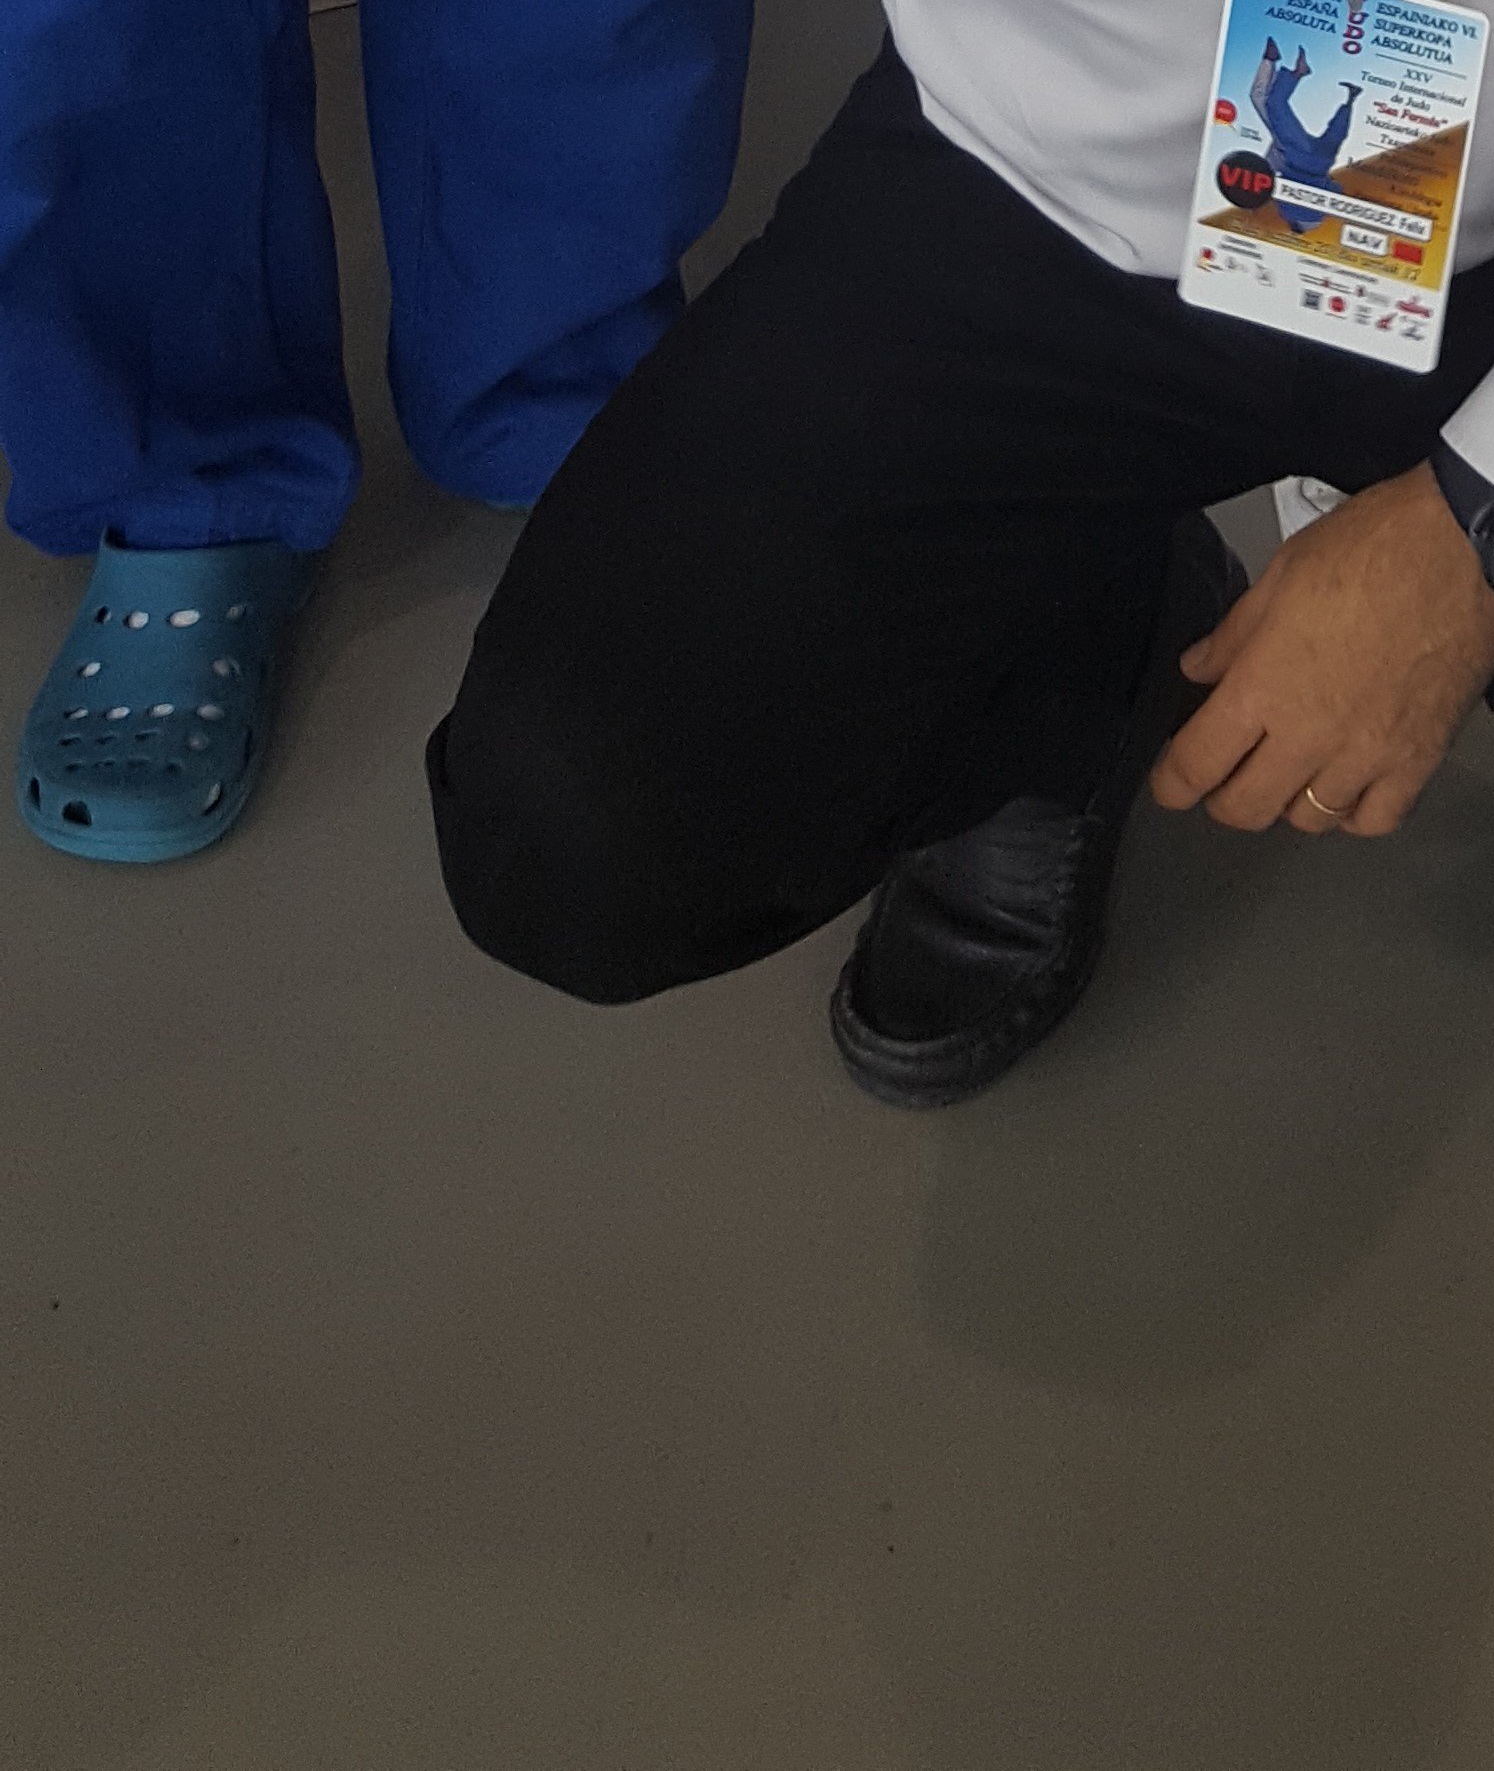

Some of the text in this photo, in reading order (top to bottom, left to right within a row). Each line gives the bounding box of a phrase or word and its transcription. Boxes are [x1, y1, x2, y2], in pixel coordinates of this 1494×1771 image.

[1265, 6, 1337, 34] ABSOLUTA
[1376, 3, 1458, 34] ESPAINIAKO
[1373, 18, 1453, 49] SUPERKOPA
[1370, 35, 1454, 65] ABSOLUTUA
[1403, 68, 1433, 84] XXV
[1398, 81, 1467, 108] Internacional
[1219, 163, 1273, 194] VIP
[1280, 183, 1327, 209] PASTOR
